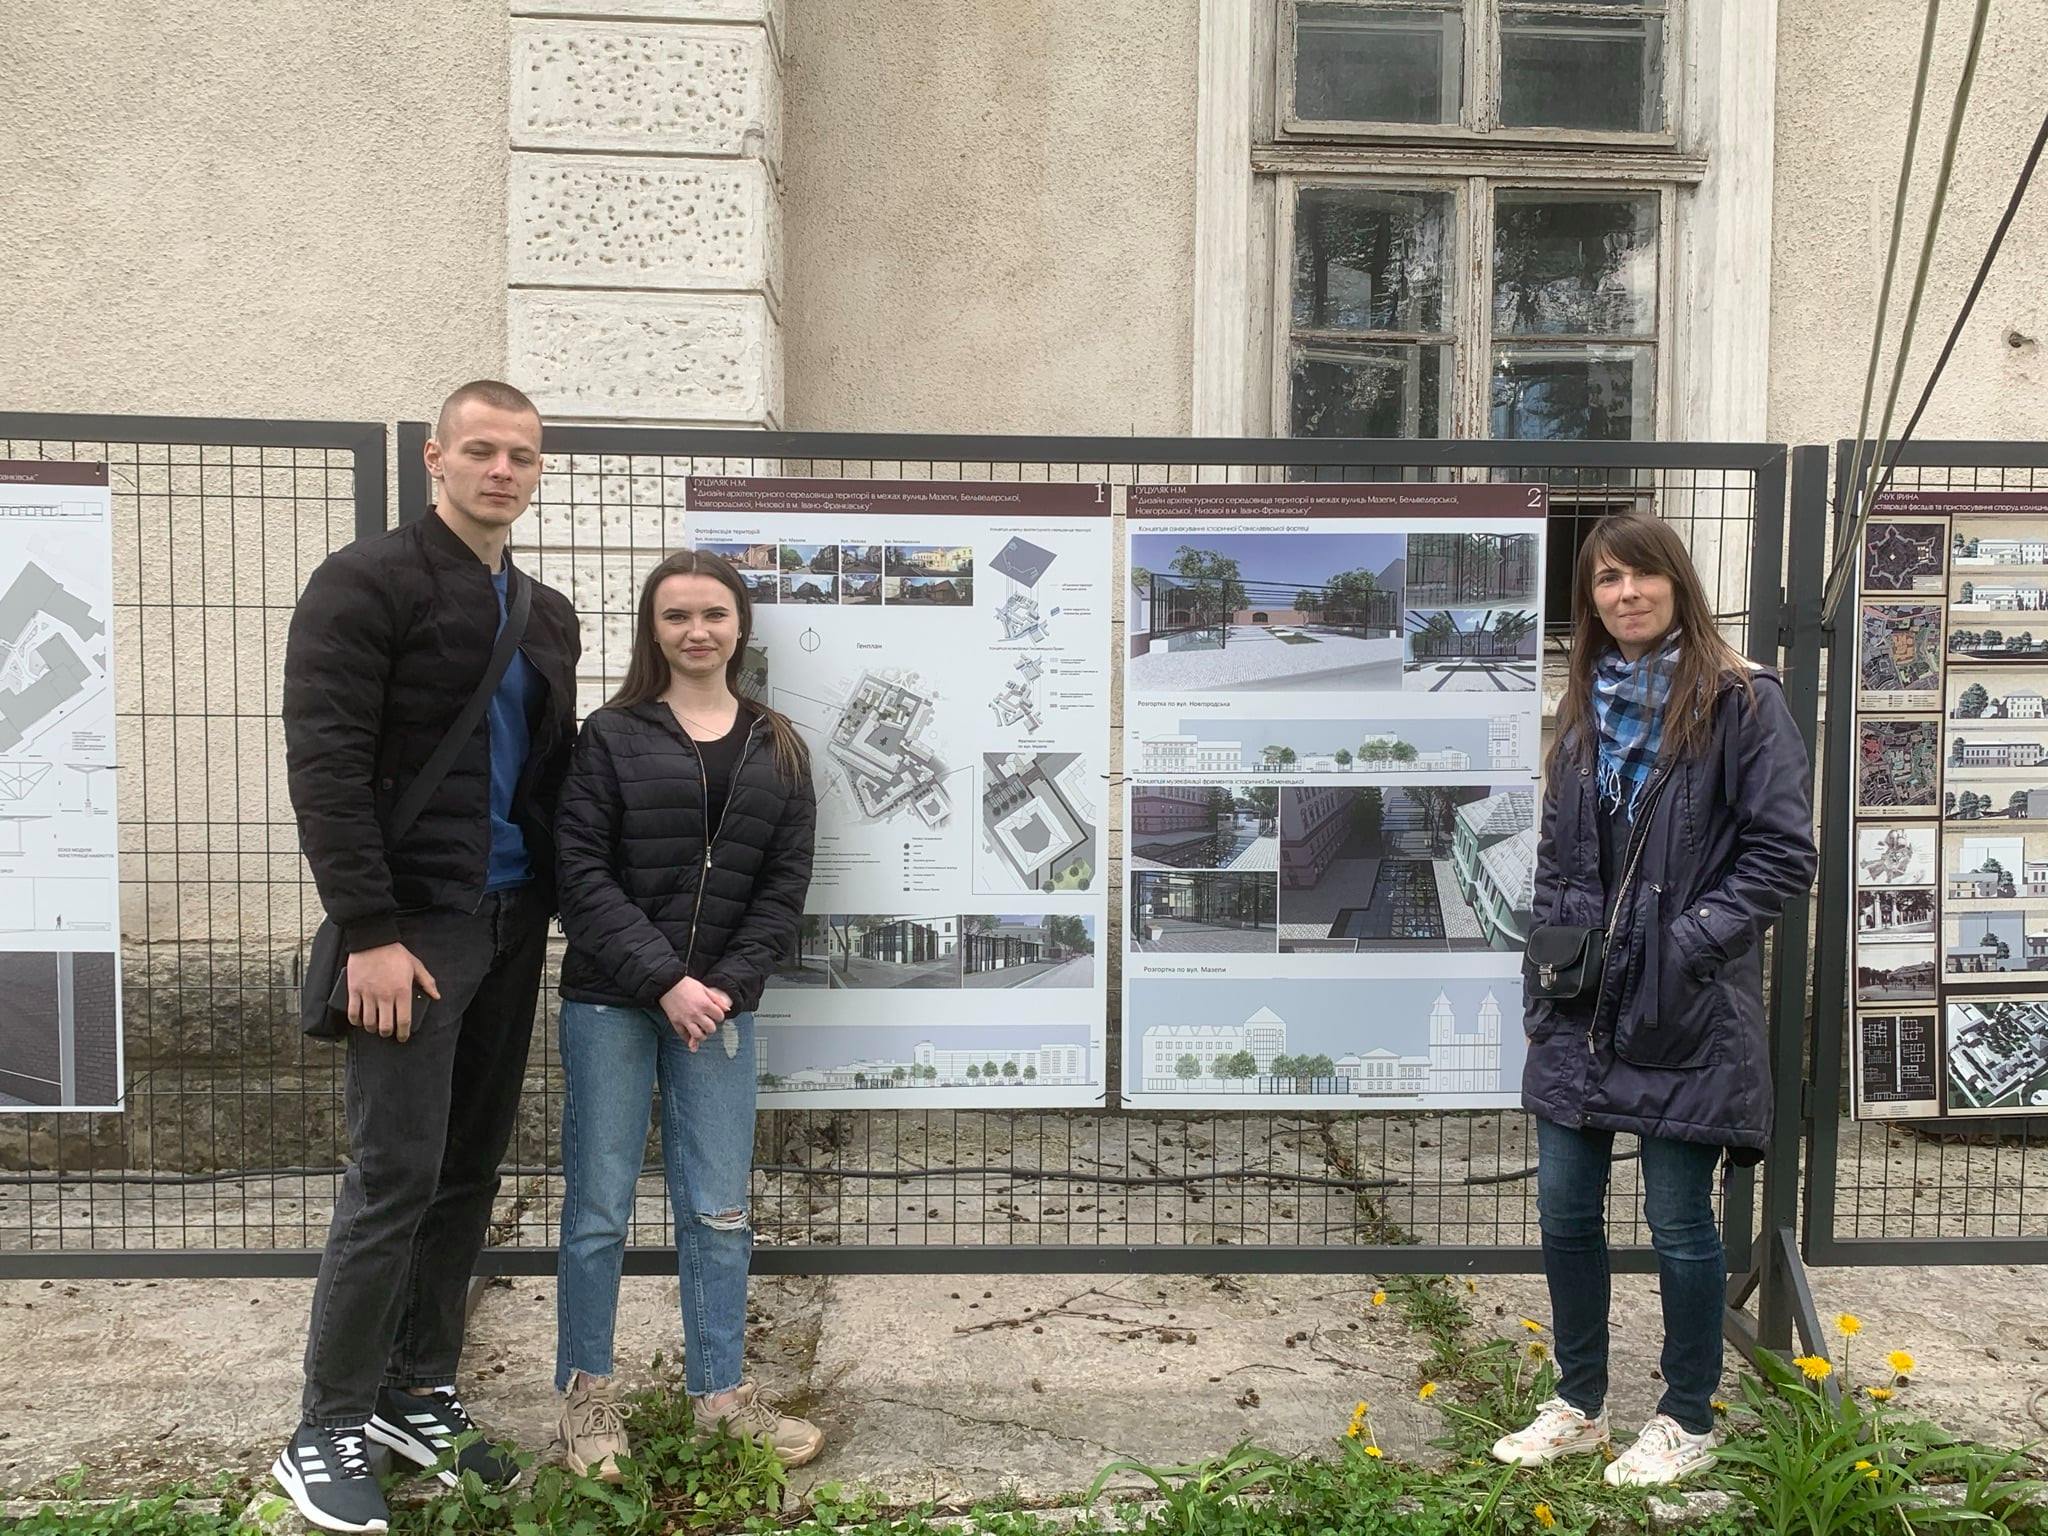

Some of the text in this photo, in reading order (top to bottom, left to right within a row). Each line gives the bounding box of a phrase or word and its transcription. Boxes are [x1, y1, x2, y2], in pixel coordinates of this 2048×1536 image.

[694, 479, 728, 487] ГУЦУЛЯК
[1094, 484, 1104, 503] 1
[1135, 486, 1169, 494] ГУЦУЛЯК
[786, 491, 833, 500] середовища
[1527, 487, 1541, 508] 2
[1225, 498, 1272, 506] середовища
[1943, 504, 1992, 512] пристосування
[1994, 505, 2019, 513] споруд
